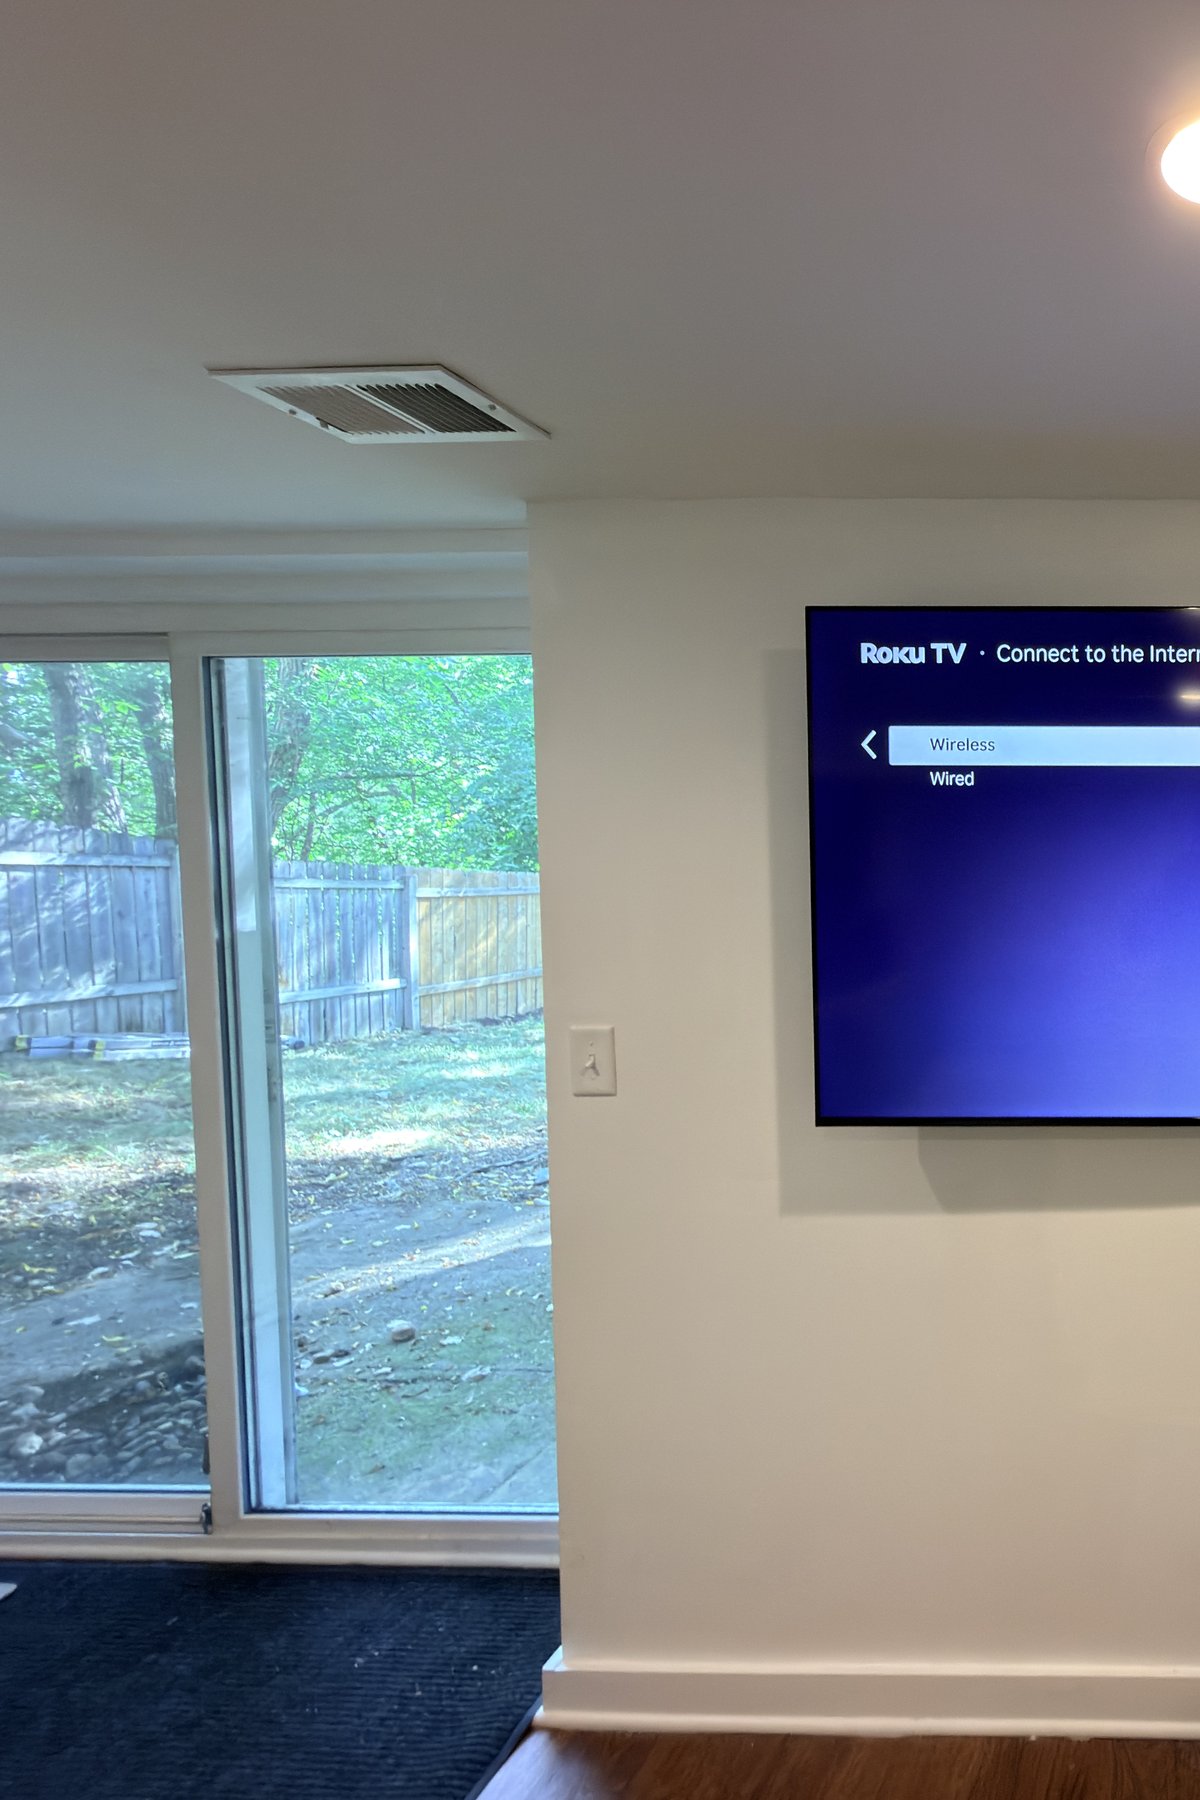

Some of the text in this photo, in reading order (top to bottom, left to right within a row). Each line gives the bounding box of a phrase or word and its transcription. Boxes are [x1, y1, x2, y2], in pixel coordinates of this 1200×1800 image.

[930, 642, 967, 664] TV
[996, 643, 1080, 663] Connect
[1084, 644, 1106, 663] to
[1110, 643, 1145, 663] the
[929, 737, 996, 752] Wireless
[929, 770, 975, 787] Wired
